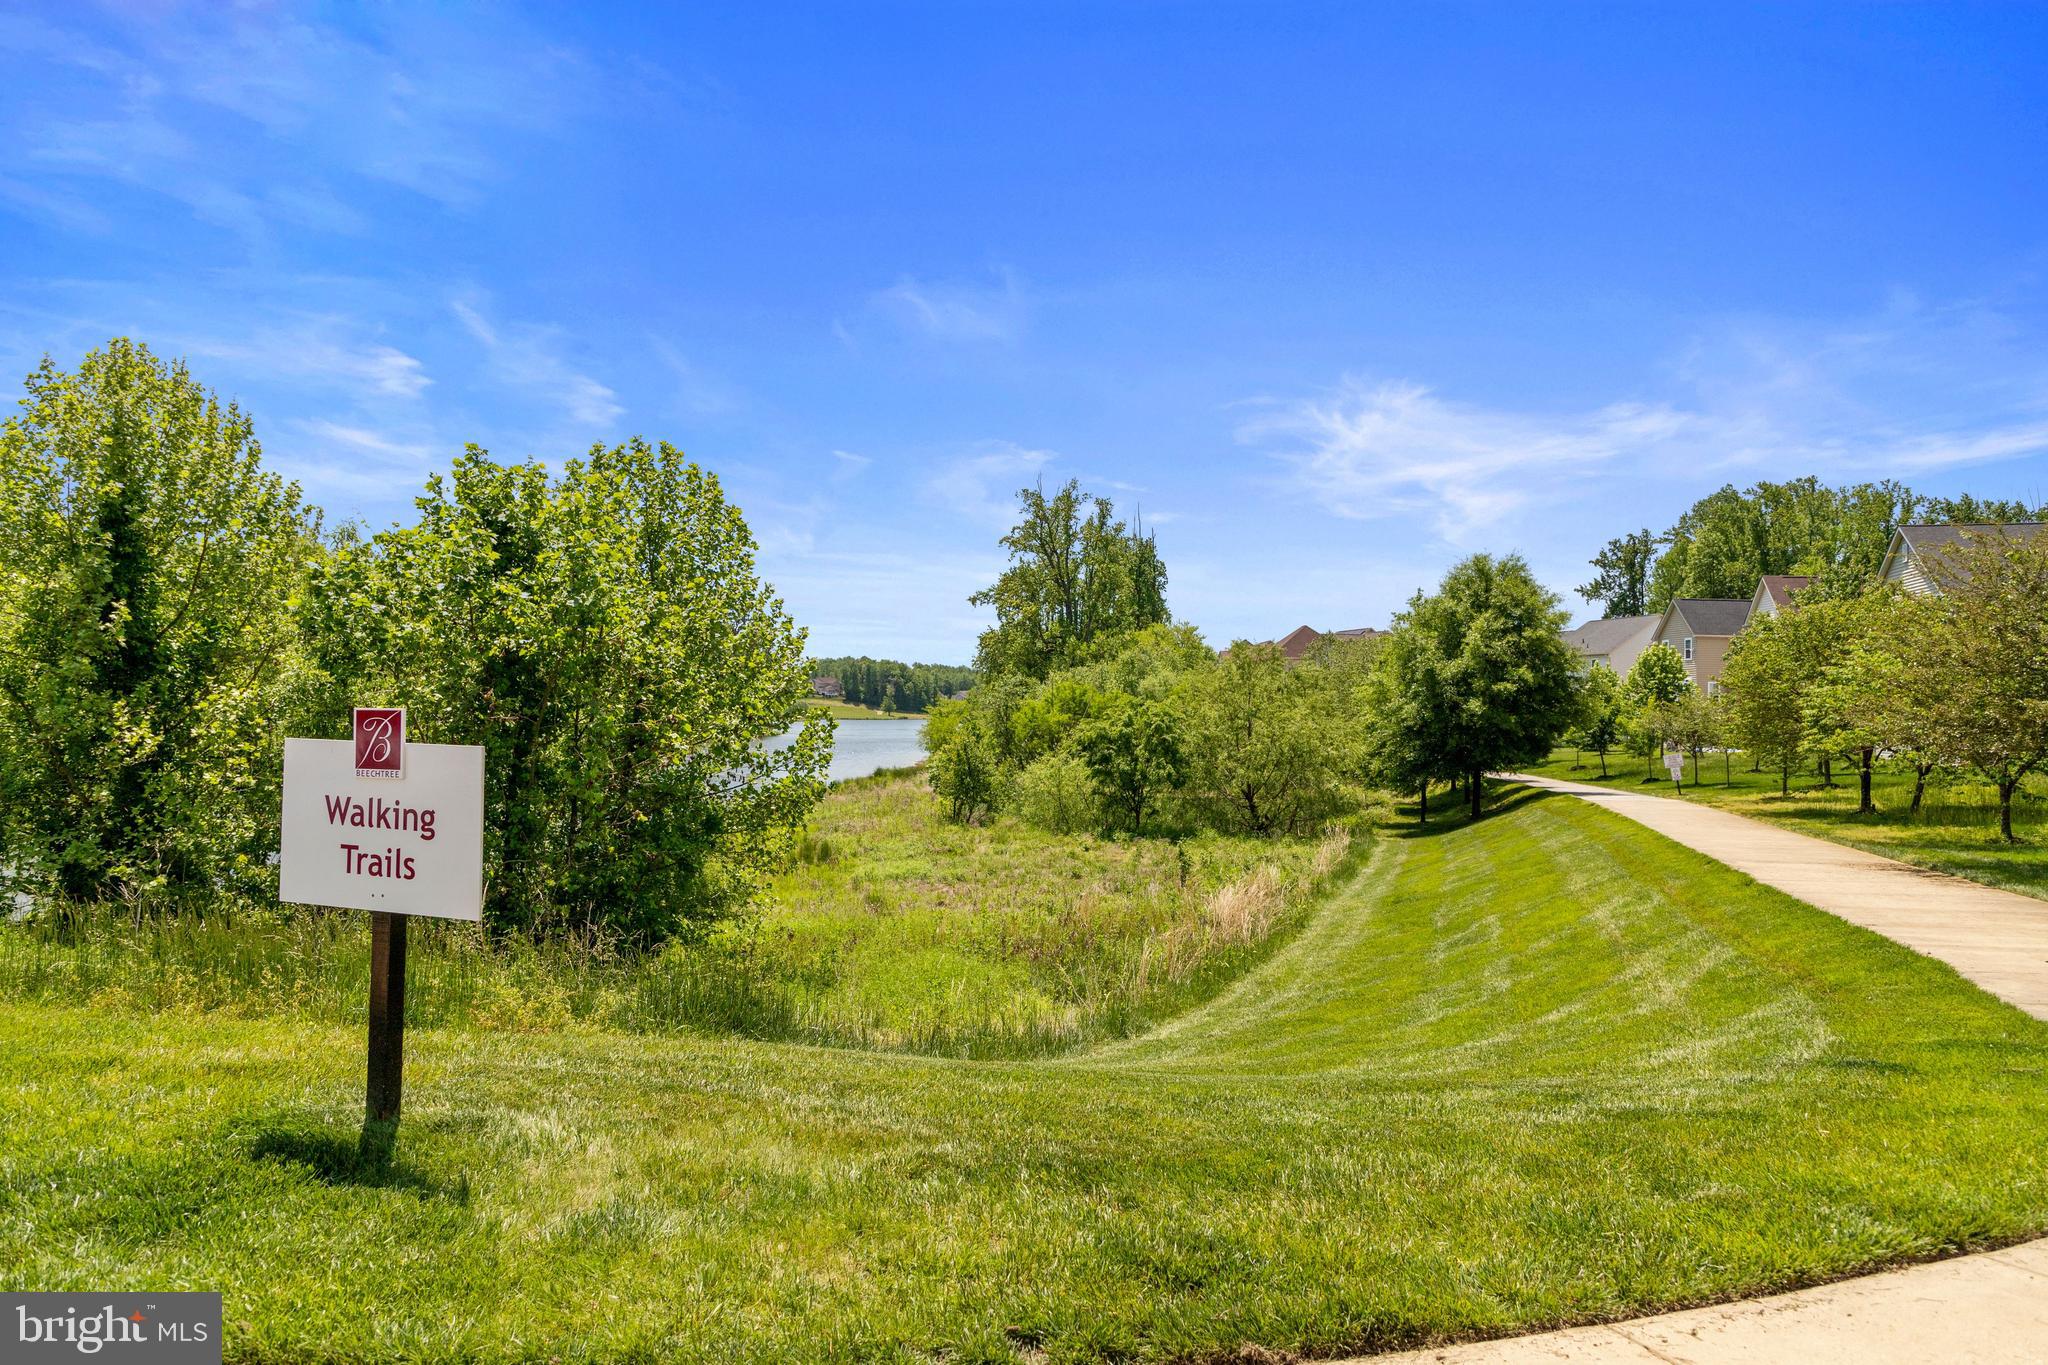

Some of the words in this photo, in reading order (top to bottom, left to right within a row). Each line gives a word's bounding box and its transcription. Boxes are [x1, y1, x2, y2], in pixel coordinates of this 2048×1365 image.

[357, 710, 401, 768] B
[356, 769, 400, 778] BEECHTREE
[324, 794, 436, 841] Walking
[340, 843, 416, 880] Trails
